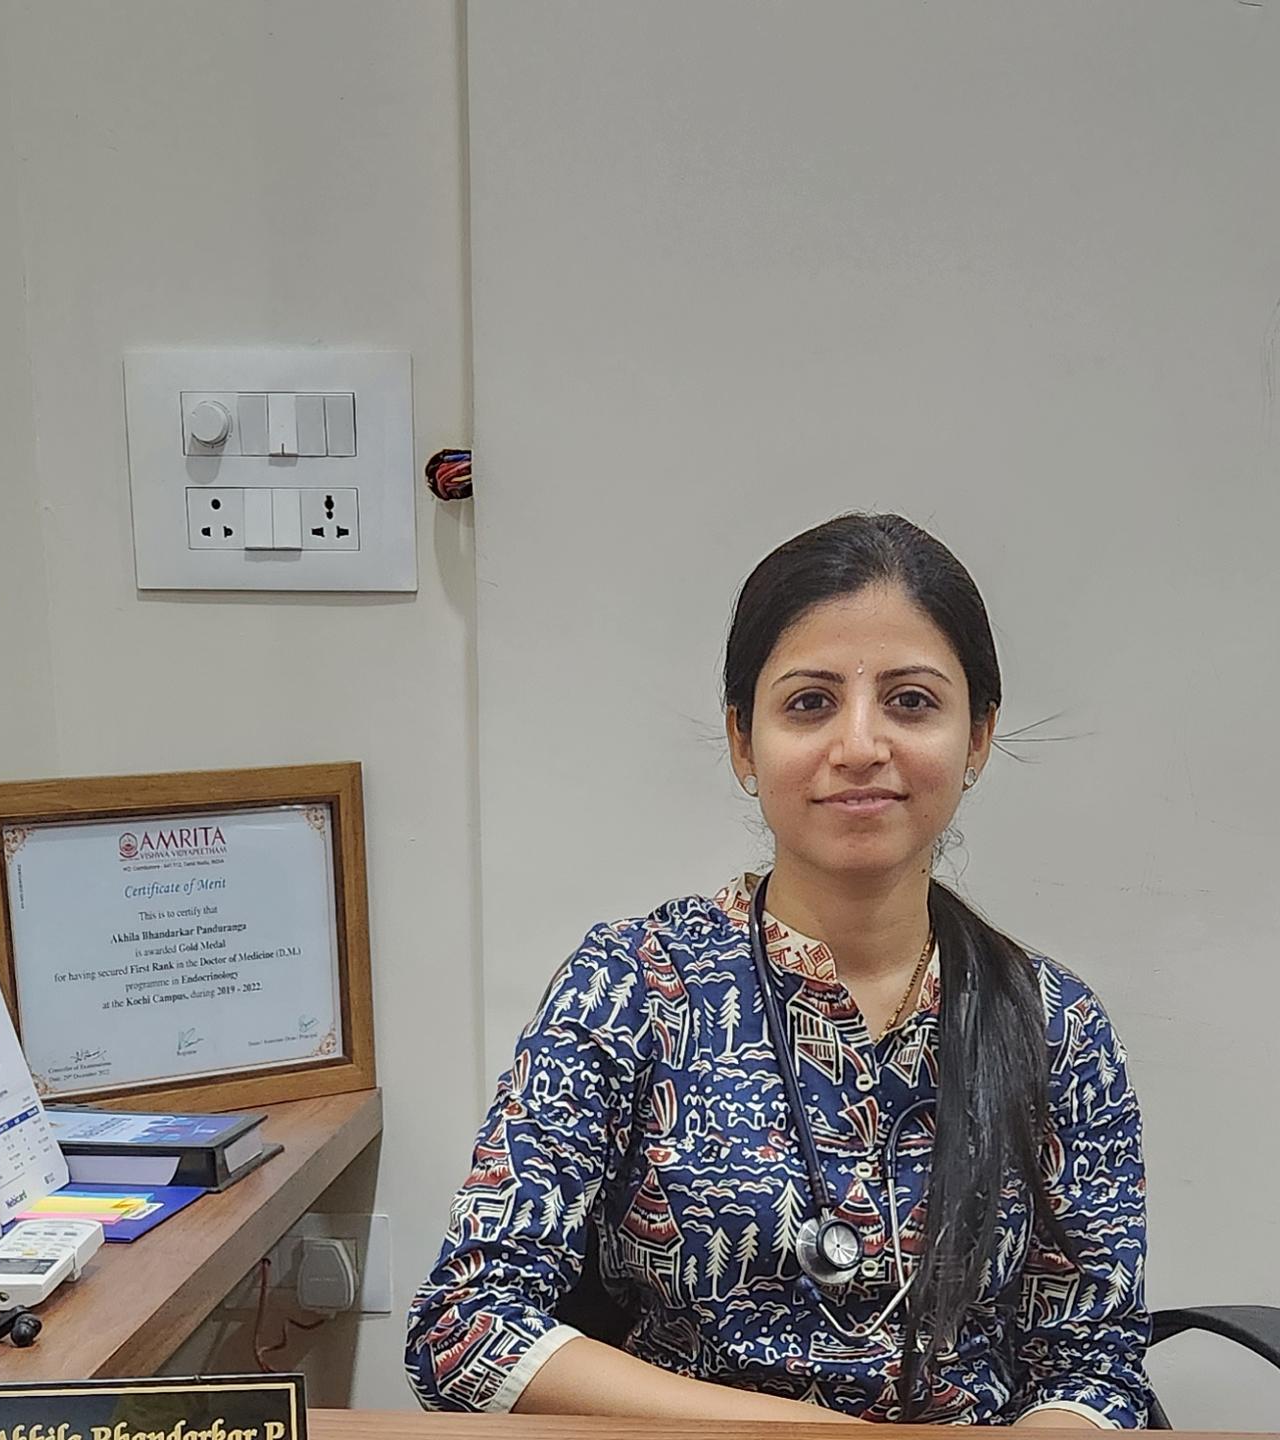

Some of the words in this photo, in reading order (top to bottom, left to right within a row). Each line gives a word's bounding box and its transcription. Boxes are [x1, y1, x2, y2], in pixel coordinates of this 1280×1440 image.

[140, 826, 226, 851] AMRITA
[125, 882, 180, 899] Certificate
[184, 878, 196, 895] of
[197, 877, 226, 891] Merit
[138, 911, 156, 921] This
[158, 911, 166, 919] is
[167, 910, 174, 918] to
[177, 907, 201, 919] certify
[203, 906, 218, 915] that
[111, 932, 140, 944] Akhila
[142, 927, 194, 941] Bhandarkar
[196, 922, 247, 935] Panduranga
[144, 946, 177, 957] awarded
[178, 942, 198, 953] Gold
[200, 939, 226, 950] Medal
[54, 972, 67, 982] for
[68, 970, 96, 982] having
[97, 967, 128, 978] secured
[130, 964, 150, 974] First
[152, 961, 174, 972] Rank
[177, 961, 184, 969] in
[186, 959, 198, 968] the
[199, 955, 226, 967] Doctor
[228, 953, 237, 963] of
[238, 950, 275, 963] Medicine
[276, 946, 302, 959] (D.M.)
[125, 979, 170, 993] programme
[171, 977, 179, 986] in
[181, 970, 238, 985] Endocrinology
[102, 1000, 110, 1010] at
[112, 998, 124, 1009] the
[126, 995, 151, 1006] Kochi
[152, 991, 189, 1005] Campus,
[190, 988, 216, 1000] during
[217, 985, 236, 995] 2019
